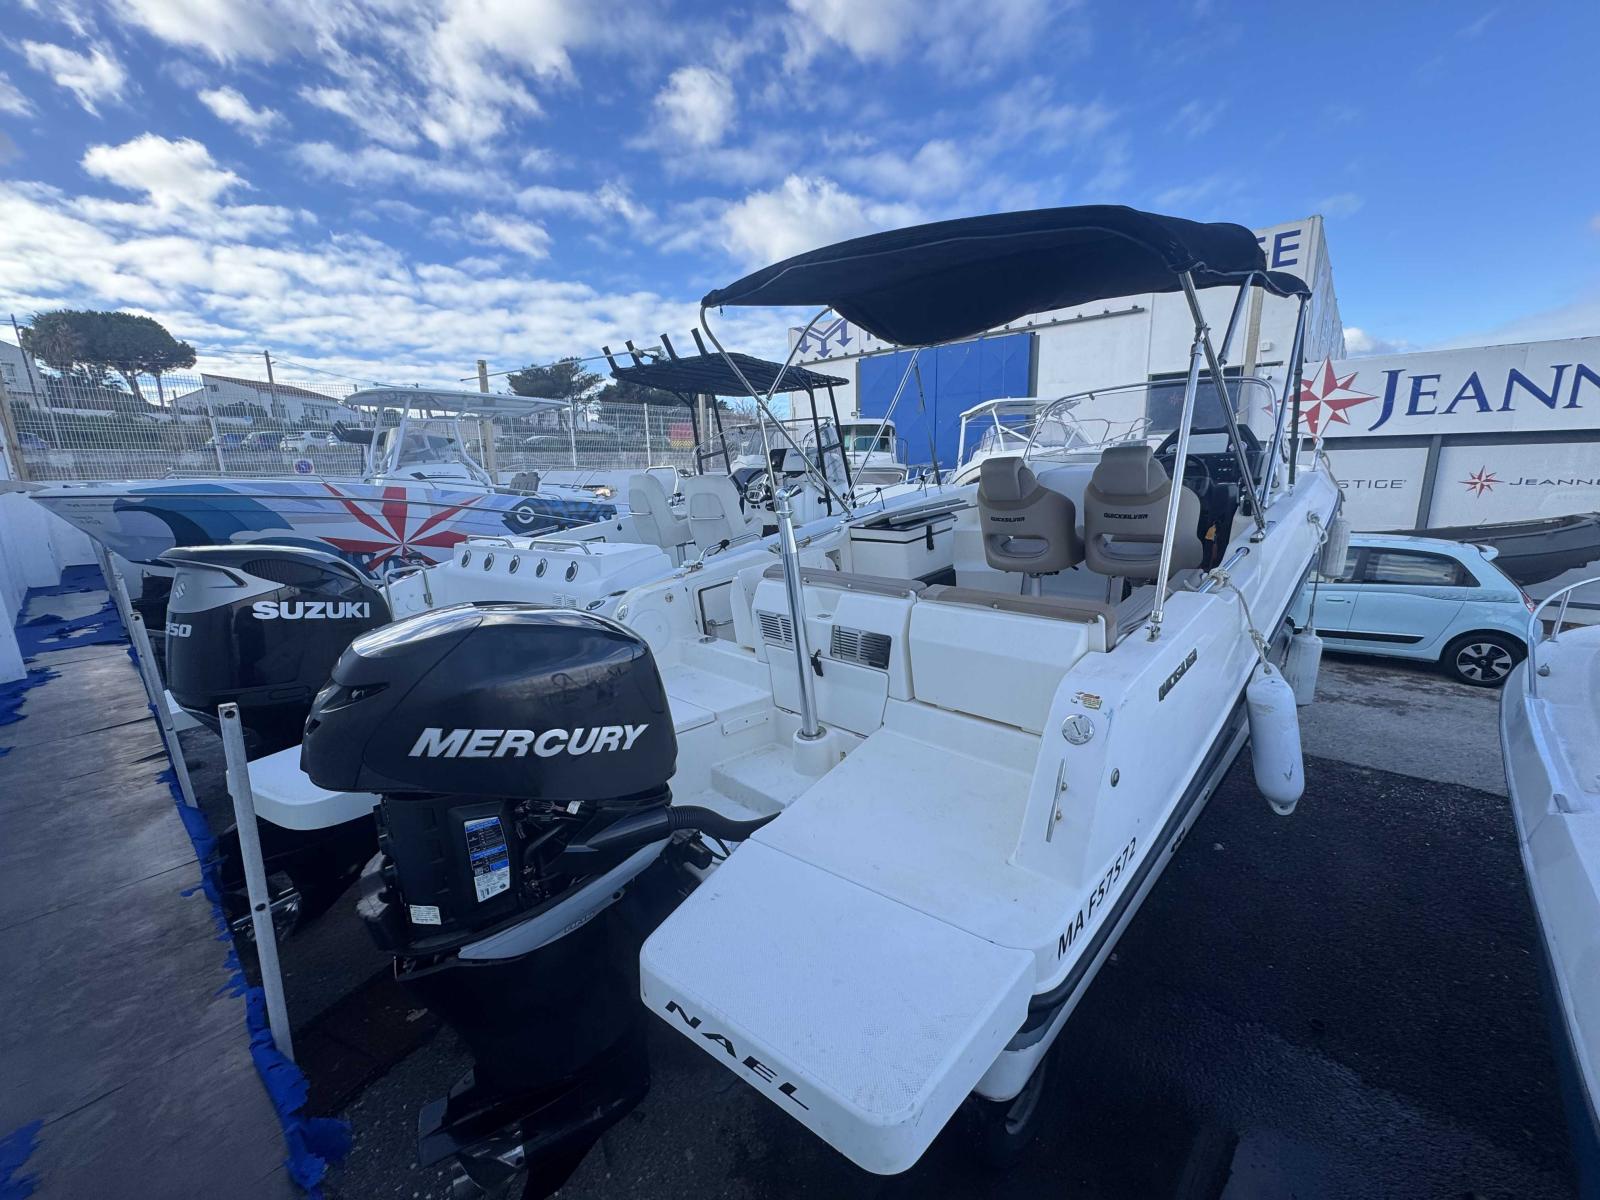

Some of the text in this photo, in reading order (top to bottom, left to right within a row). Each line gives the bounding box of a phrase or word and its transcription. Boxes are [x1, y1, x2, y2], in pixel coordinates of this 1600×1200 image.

[1508, 477, 1600, 486] JEANN
[252, 601, 371, 620] SUZUKI
[407, 723, 650, 758] MERCURY
[1057, 836, 1137, 961] MA F57572
[665, 1000, 810, 1111] NAEL
